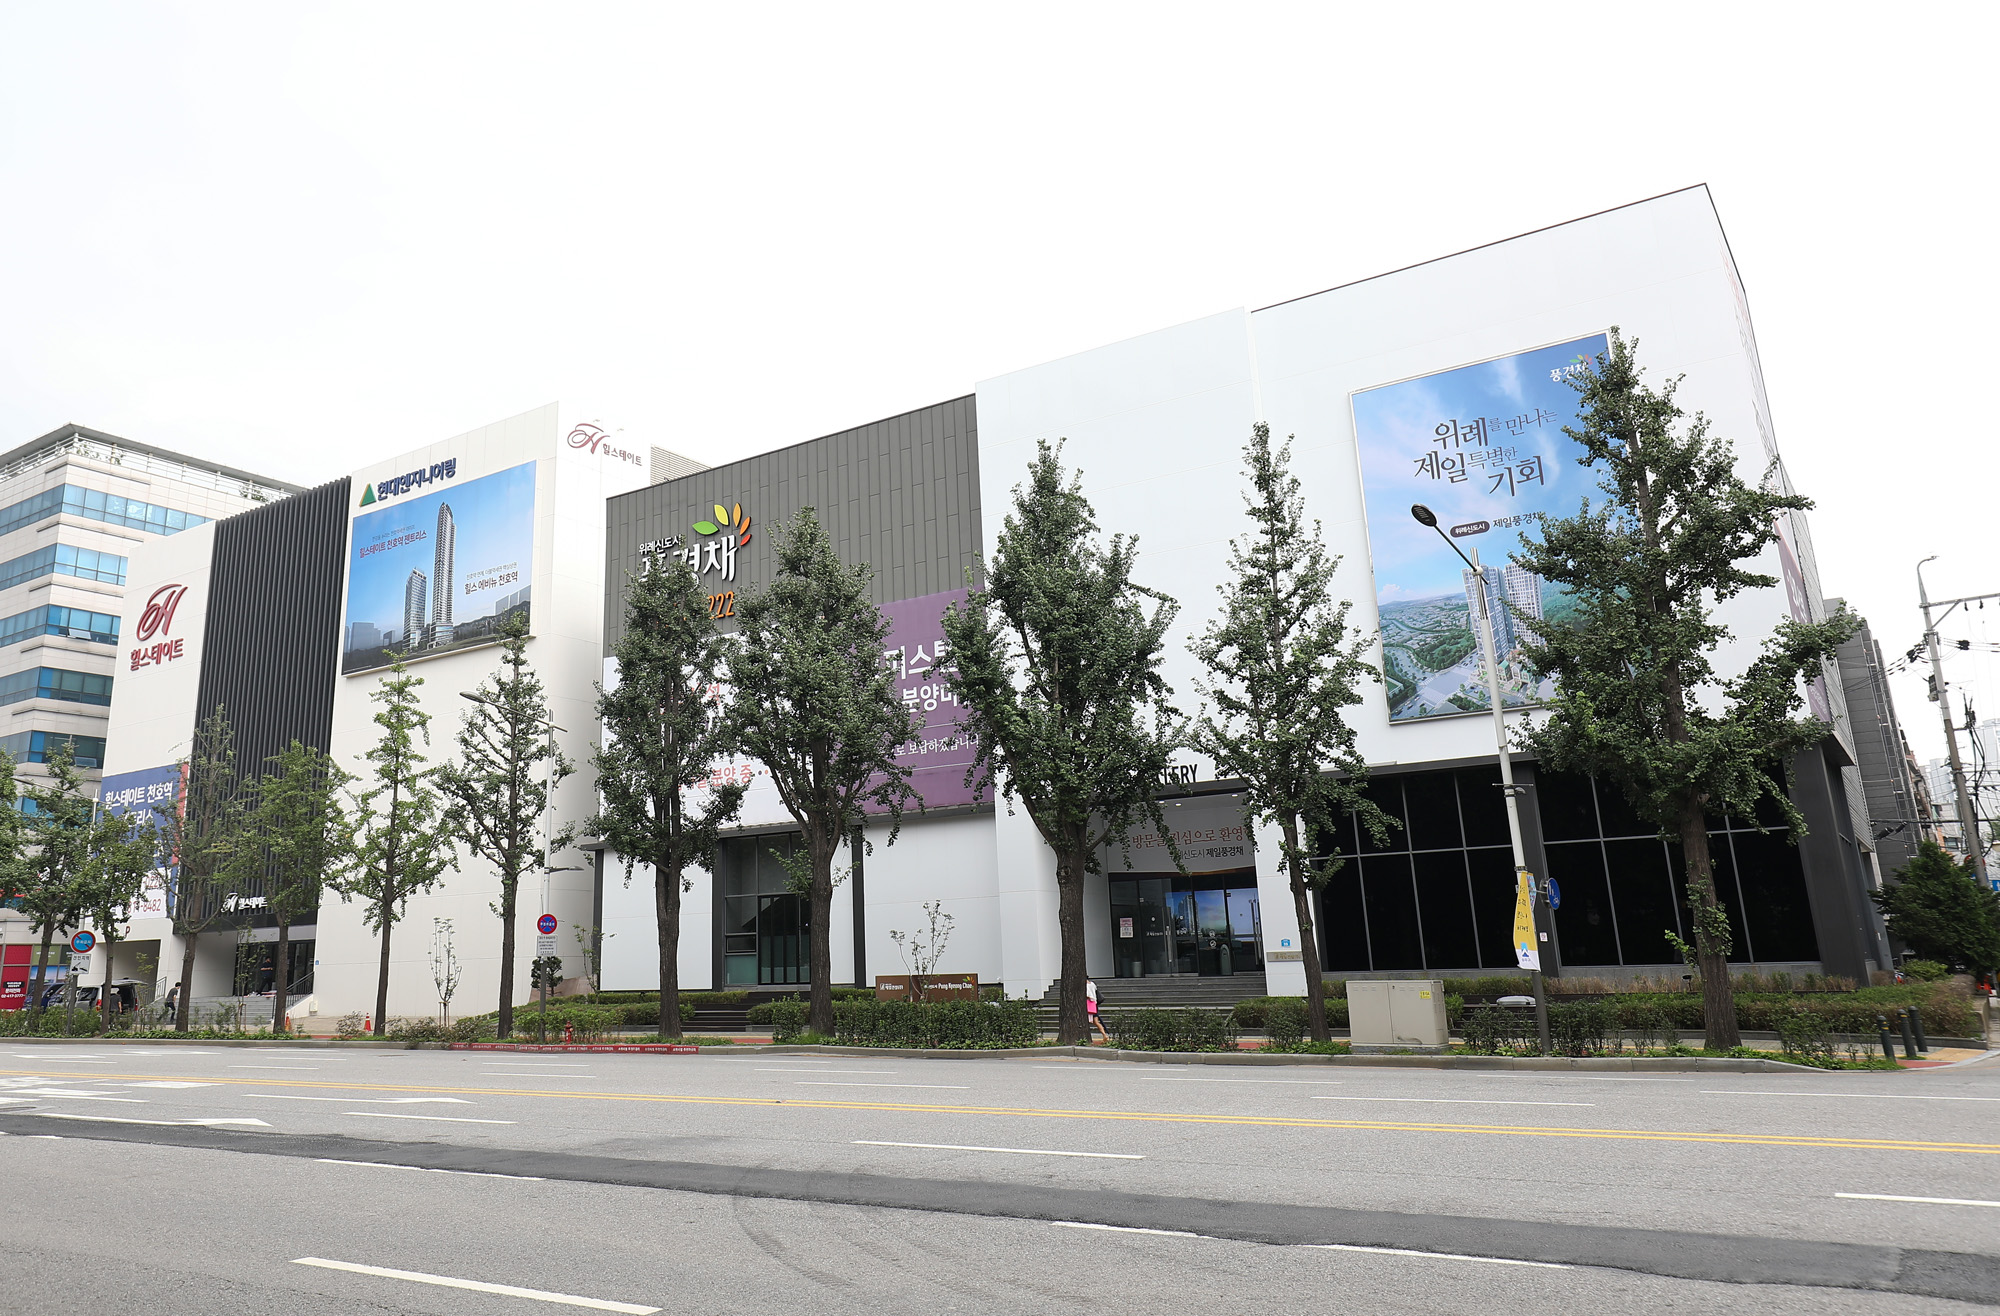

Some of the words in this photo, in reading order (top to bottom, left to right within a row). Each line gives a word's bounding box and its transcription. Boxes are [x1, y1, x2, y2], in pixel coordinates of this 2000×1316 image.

[1433, 417, 1503, 450] 위례를
[1506, 408, 1558, 436] 만나는
[603, 443, 642, 466] 힐스테이트
[377, 457, 457, 501] 현대엔지니어링
[1488, 455, 1545, 497] 기회
[1455, 523, 1486, 535] 위례신도시
[360, 542, 386, 558] 힐스테이트
[387, 536, 404, 551] 천호역
[404, 530, 427, 545] 젠트리스
[639, 533, 682, 555] 위례신도시
[465, 582, 478, 595] 힐스
[478, 577, 498, 590] 에비뉴
[499, 571, 518, 586] 천호역
[130, 638, 184, 671] 힐스테이트
[1158, 764, 1198, 785] LERY
[105, 786, 145, 810] 힐스테이트
[147, 781, 173, 803] 천호역
[1132, 833, 1167, 849] 방문을
[1170, 829, 1217, 846] 진심으로
[1206, 846, 1244, 858] 제일풍경채
[238, 896, 268, 909] 힐스테이트
[938, 982, 948, 990] Pung
